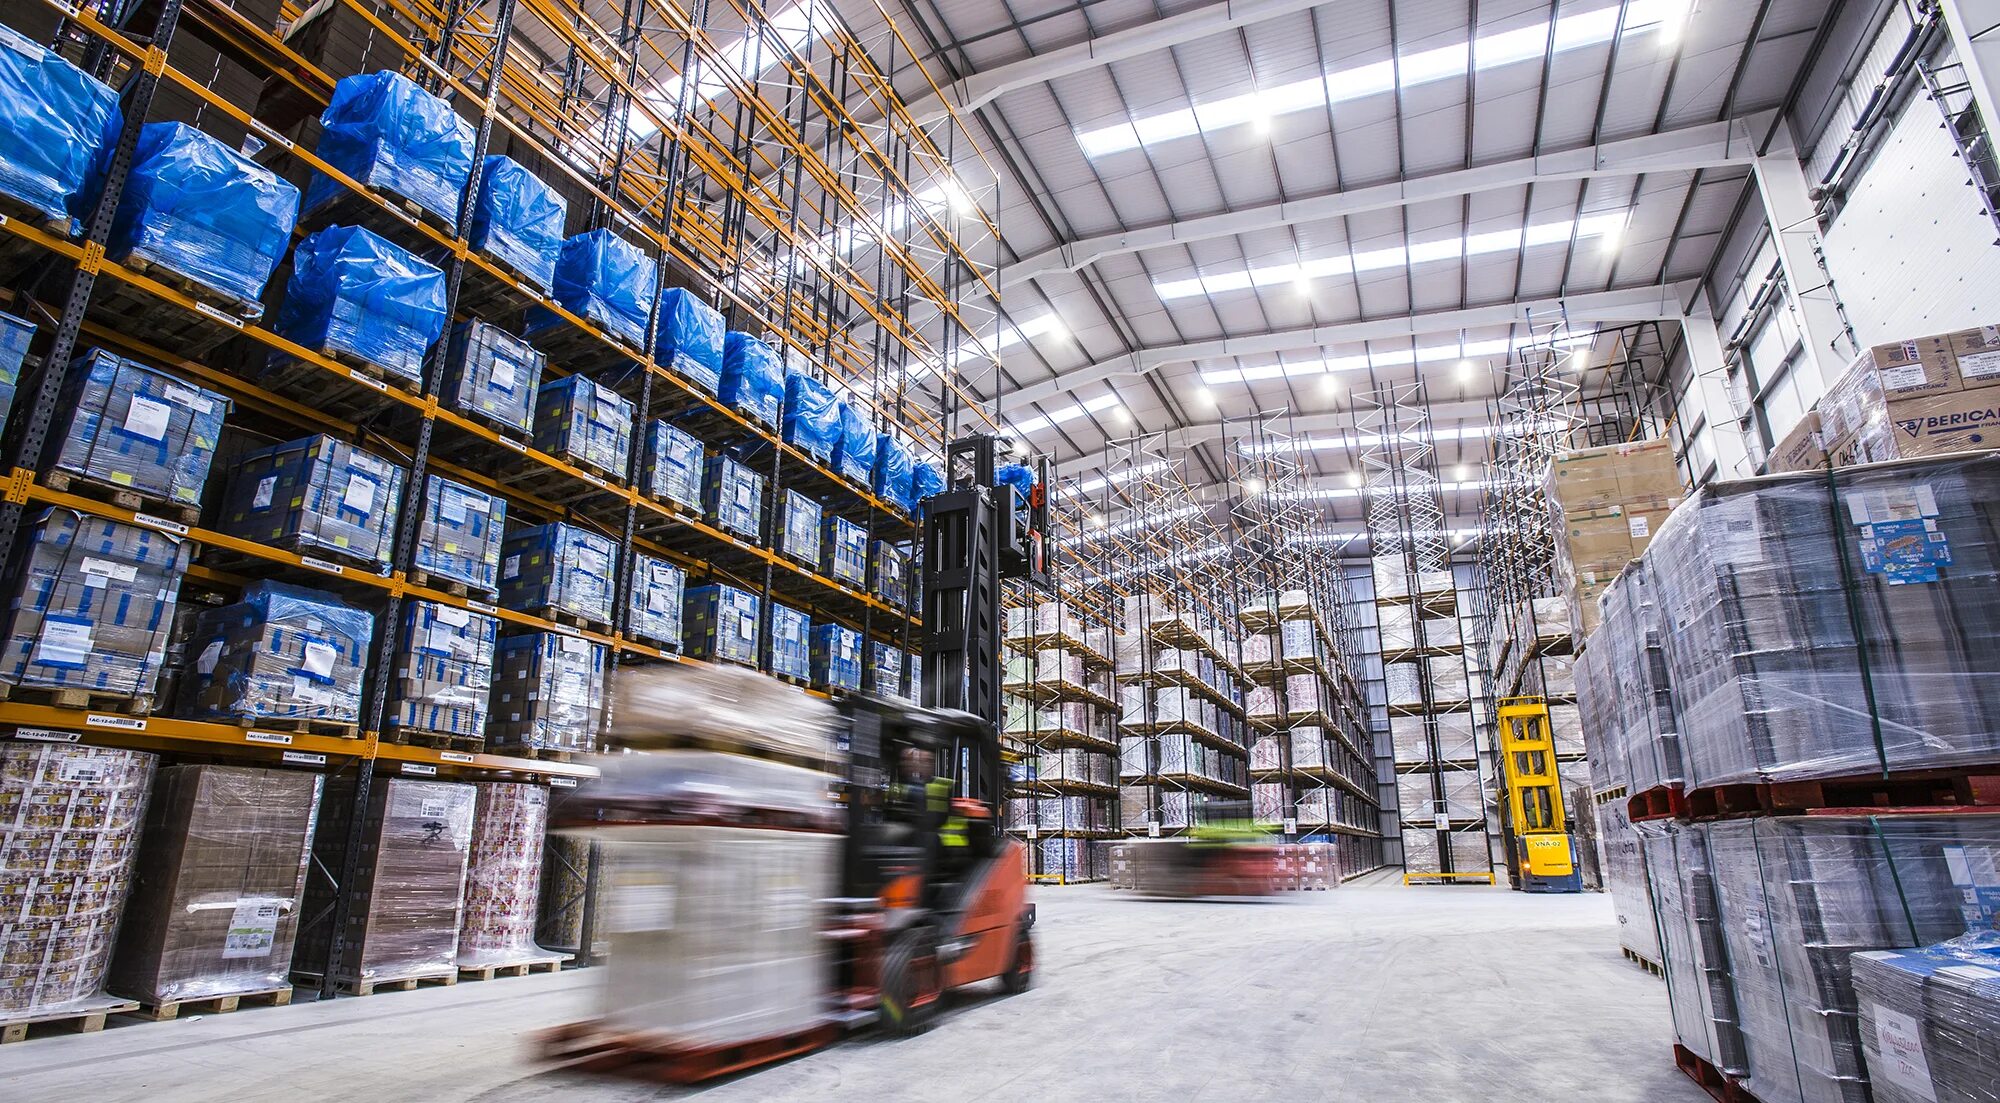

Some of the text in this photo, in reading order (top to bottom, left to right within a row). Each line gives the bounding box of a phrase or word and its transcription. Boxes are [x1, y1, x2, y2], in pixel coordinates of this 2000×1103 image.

[1897, 386, 1915, 394] MADE
[1922, 382, 1948, 390] FRANCE
[1927, 407, 2000, 428] BERICA
[88, 717, 116, 725] 1AC-12-02
